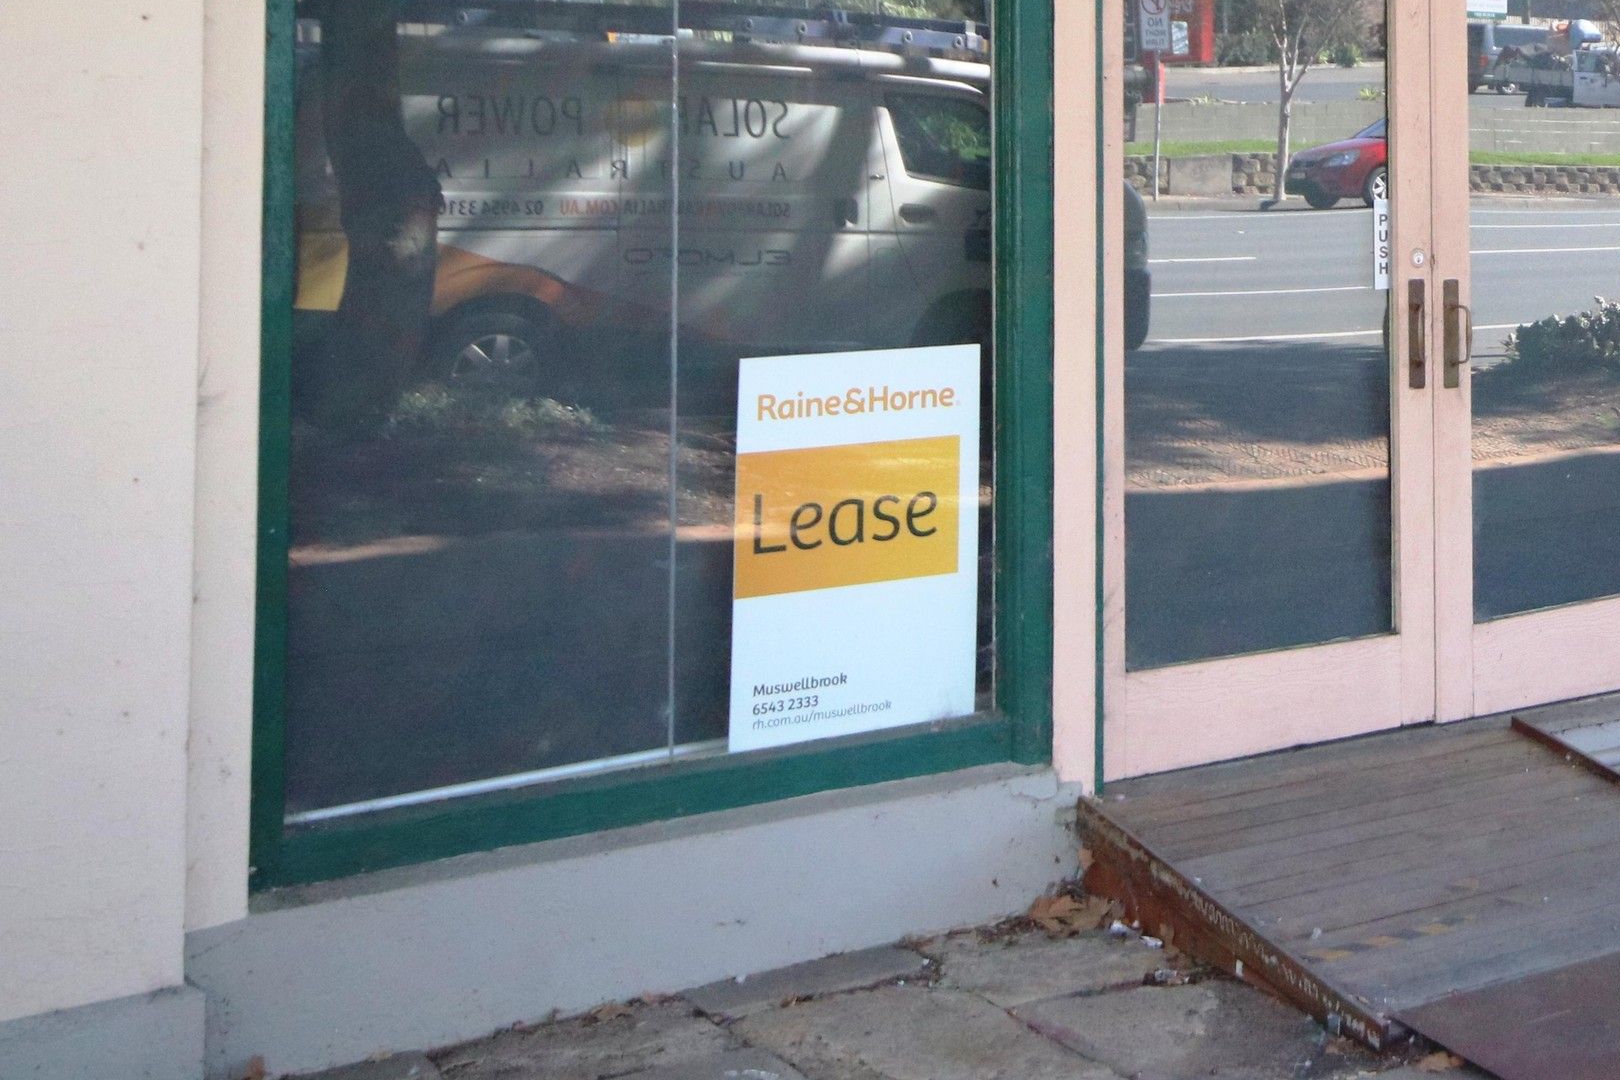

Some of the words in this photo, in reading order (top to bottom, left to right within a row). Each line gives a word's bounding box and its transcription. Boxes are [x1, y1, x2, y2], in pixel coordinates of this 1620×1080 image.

[1378, 213, 1389, 275] PUSH
[757, 385, 956, 422] Raine&Horne
[752, 490, 938, 556] Lease
[752, 672, 848, 697] Muswellbrook
[752, 699, 785, 716] 6543
[788, 694, 820, 711] 2333
[752, 699, 893, 730] rh.com.au/muswellbrook
